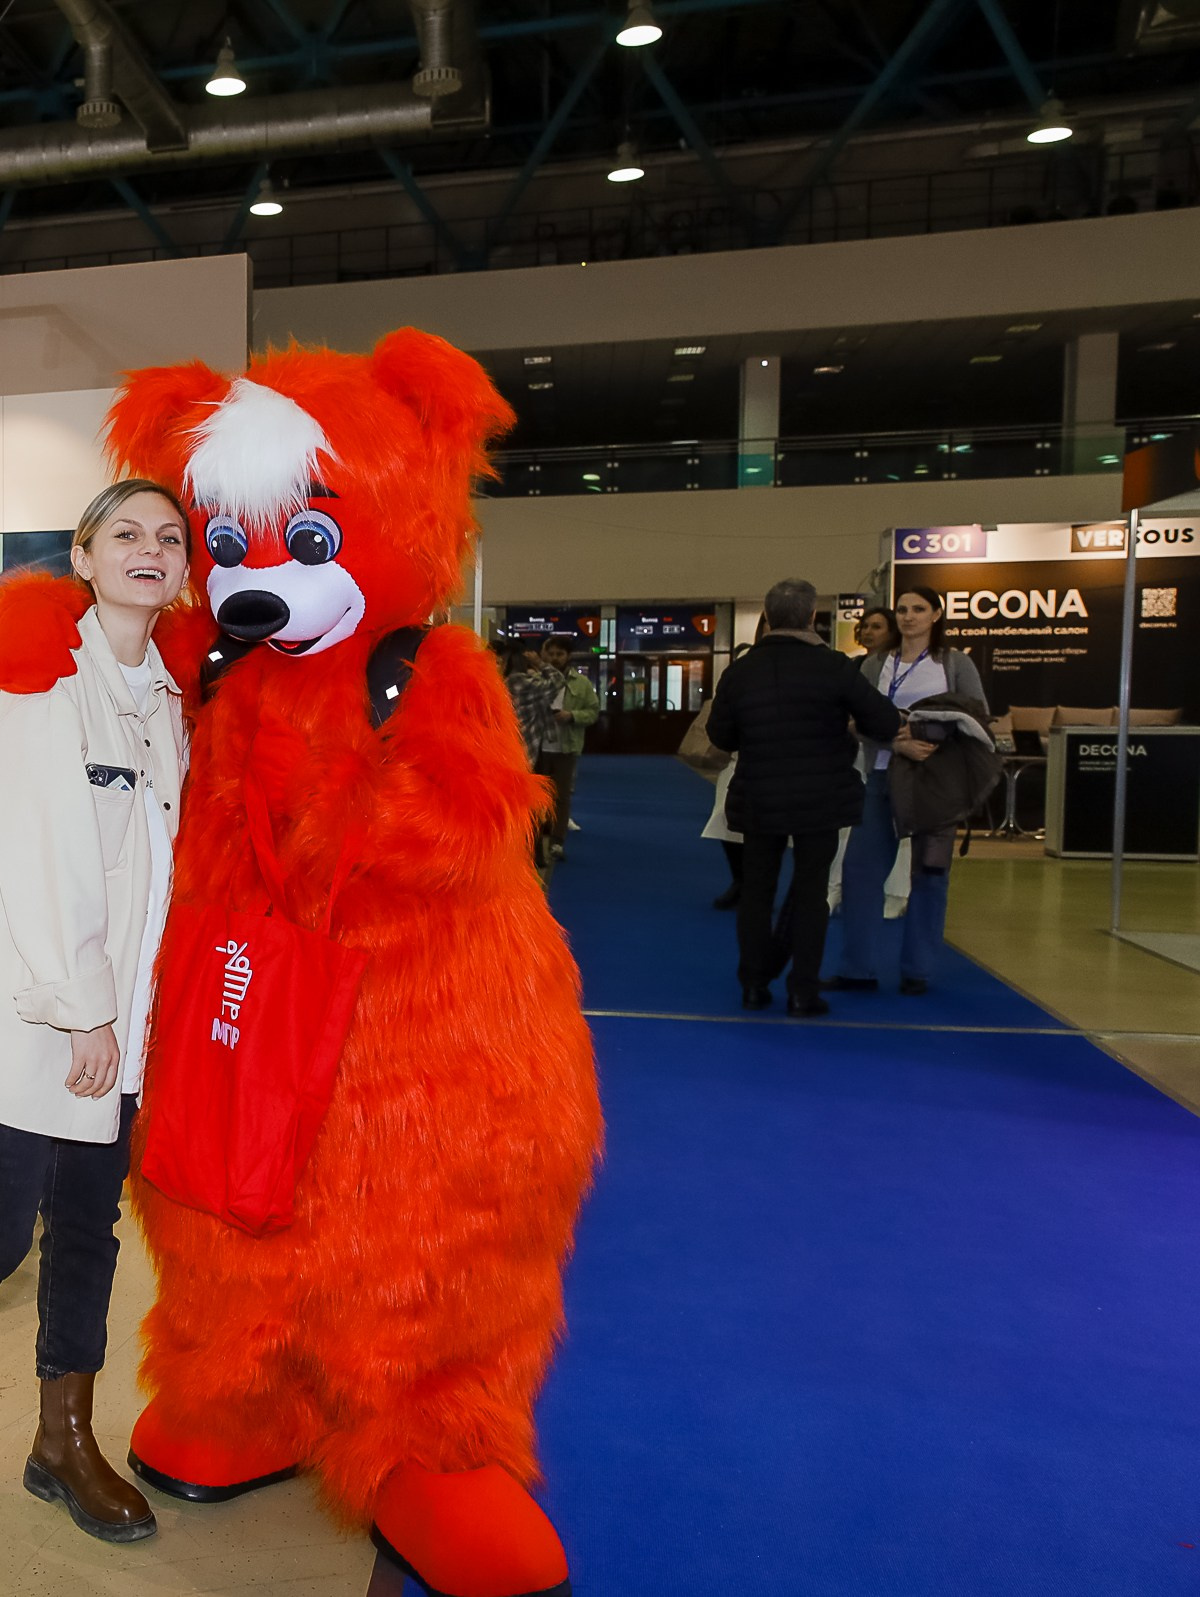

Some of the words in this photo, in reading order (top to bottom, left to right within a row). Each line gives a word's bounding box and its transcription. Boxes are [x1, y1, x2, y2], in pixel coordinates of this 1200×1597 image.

[902, 534, 921, 554] C
[925, 533, 972, 553] 301
[938, 589, 1088, 619] ECONA
[586, 621, 593, 634] 1
[701, 618, 709, 632] 1
[961, 627, 987, 636] свой
[1054, 626, 1088, 635] салон
